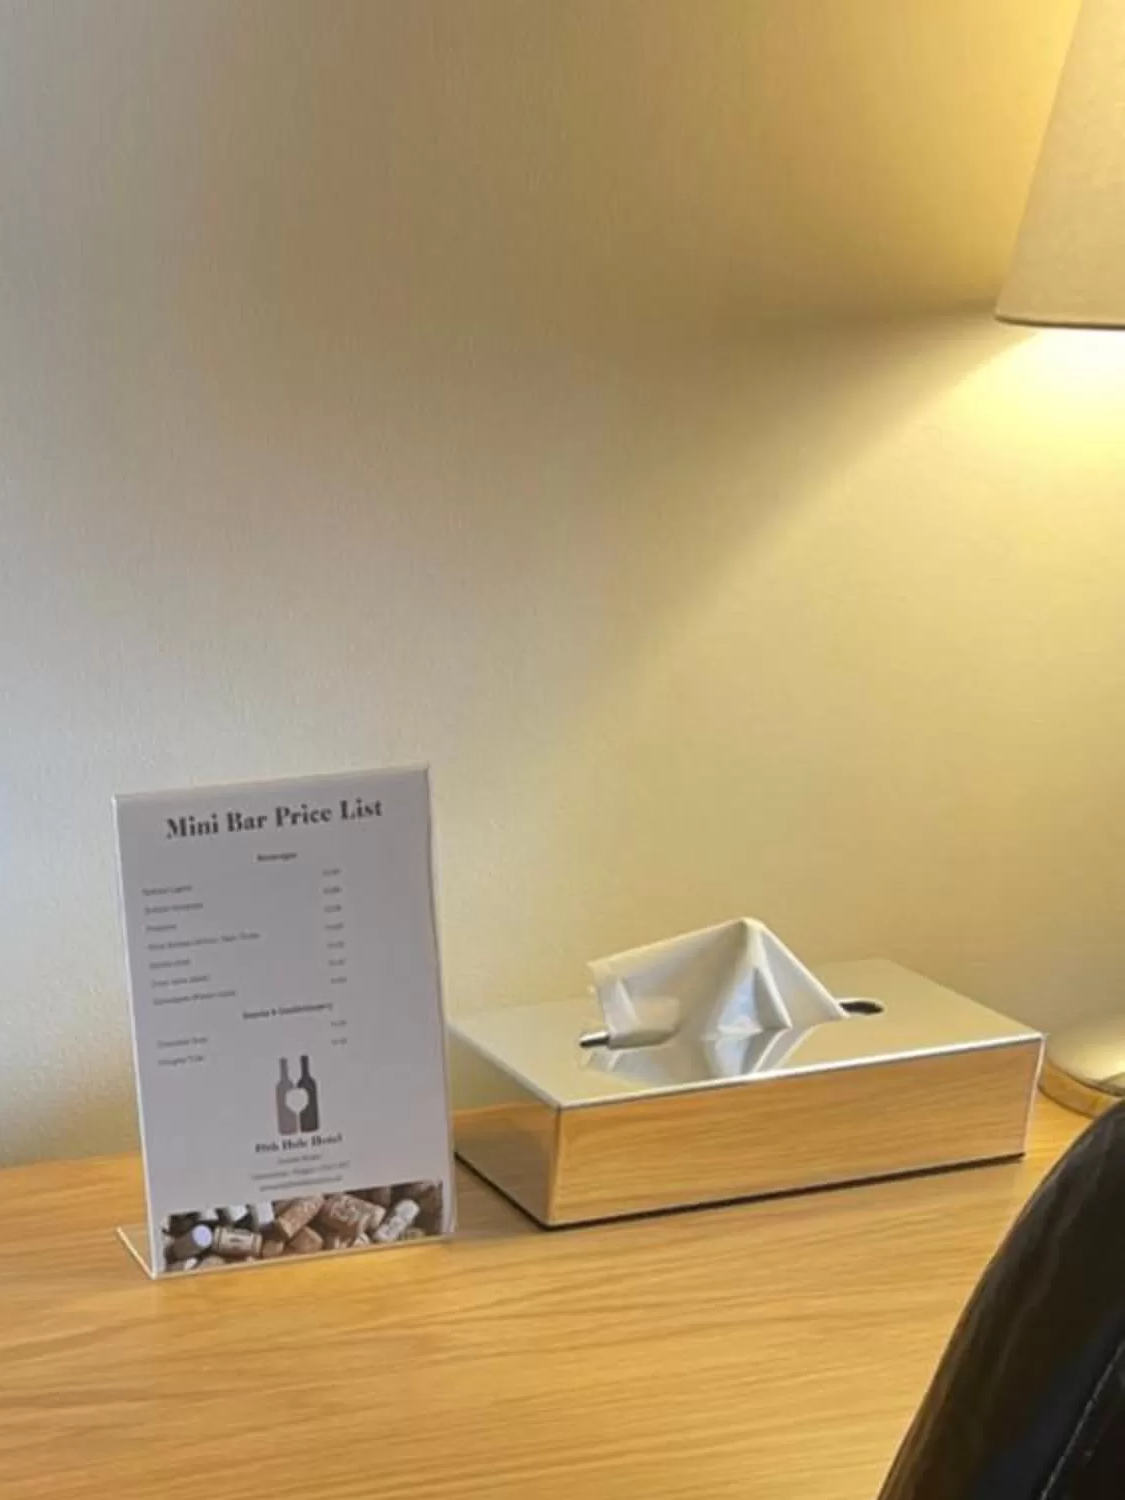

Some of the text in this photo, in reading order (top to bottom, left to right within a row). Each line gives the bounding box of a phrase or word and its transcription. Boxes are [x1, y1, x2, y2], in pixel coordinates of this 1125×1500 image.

[166, 796, 383, 839] Mini Bar Price List
